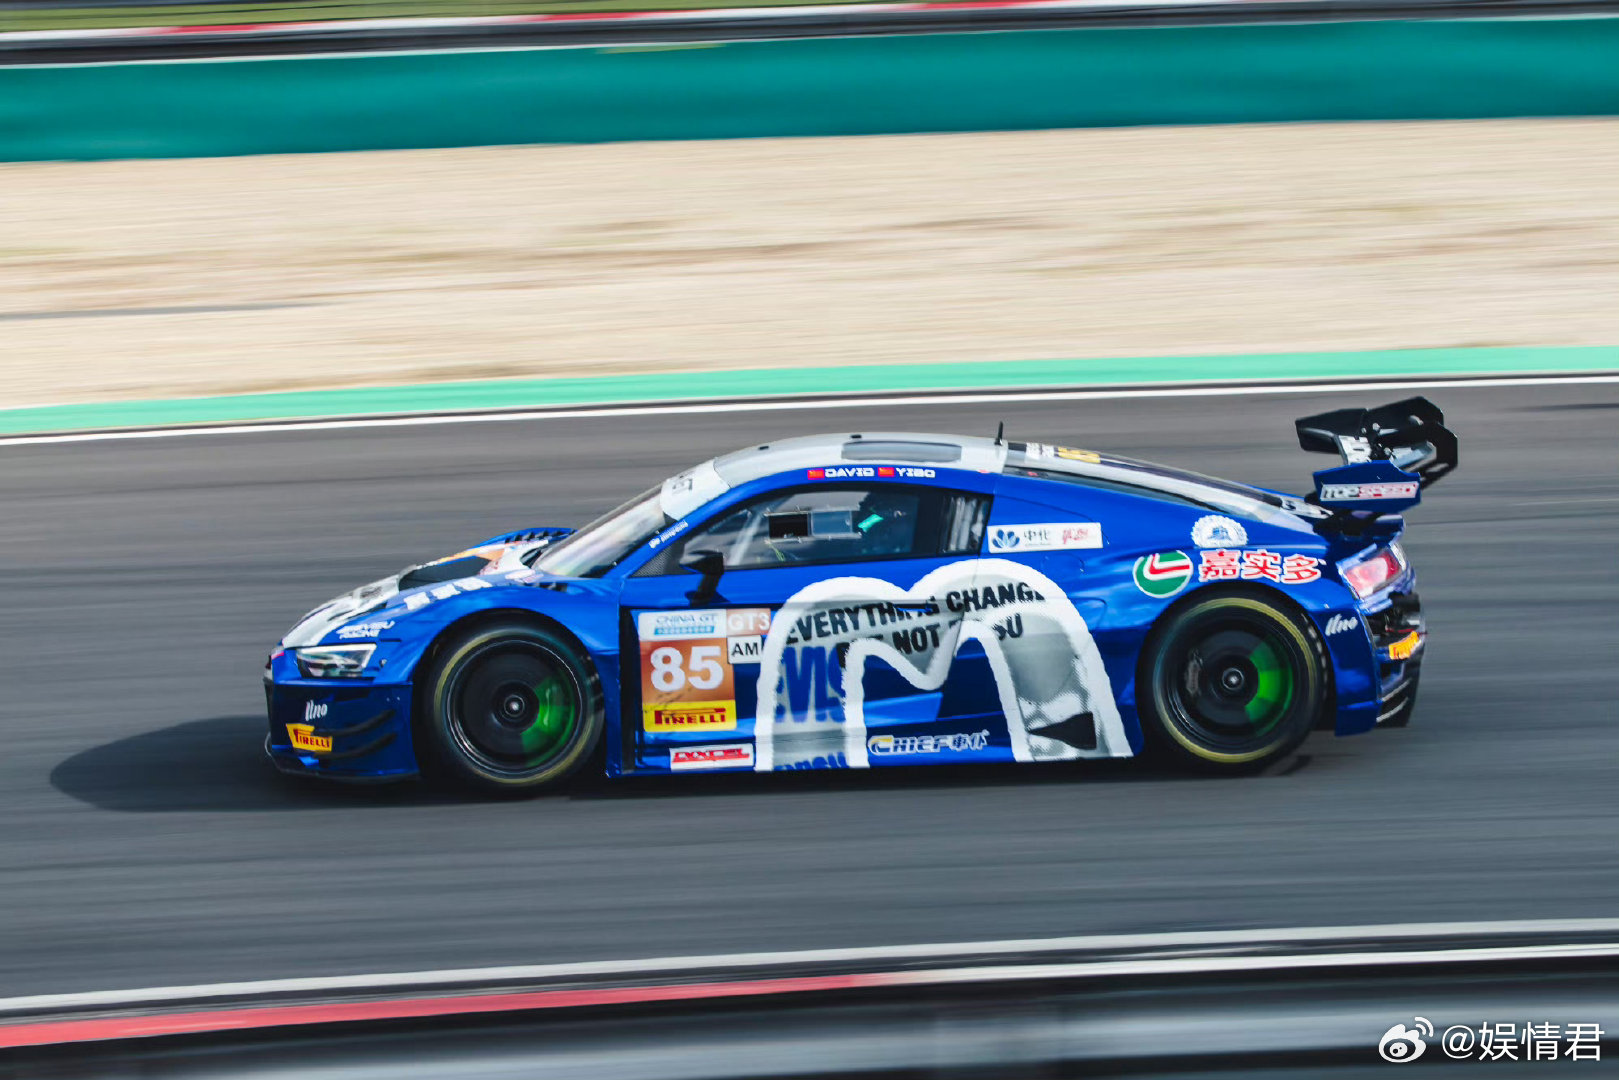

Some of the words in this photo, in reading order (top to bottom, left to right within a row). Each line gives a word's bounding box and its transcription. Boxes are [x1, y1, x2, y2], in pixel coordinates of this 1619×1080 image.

[825, 467, 875, 478] DAVID
[896, 467, 936, 478] YIBO
[1199, 549, 1321, 584] 嘉实多
[728, 612, 770, 631] GT3
[892, 623, 940, 654] NOT
[732, 642, 759, 656] AM
[651, 646, 724, 692] 85
[655, 708, 726, 724] PIRELLI
[293, 728, 330, 748] PIRELLI
